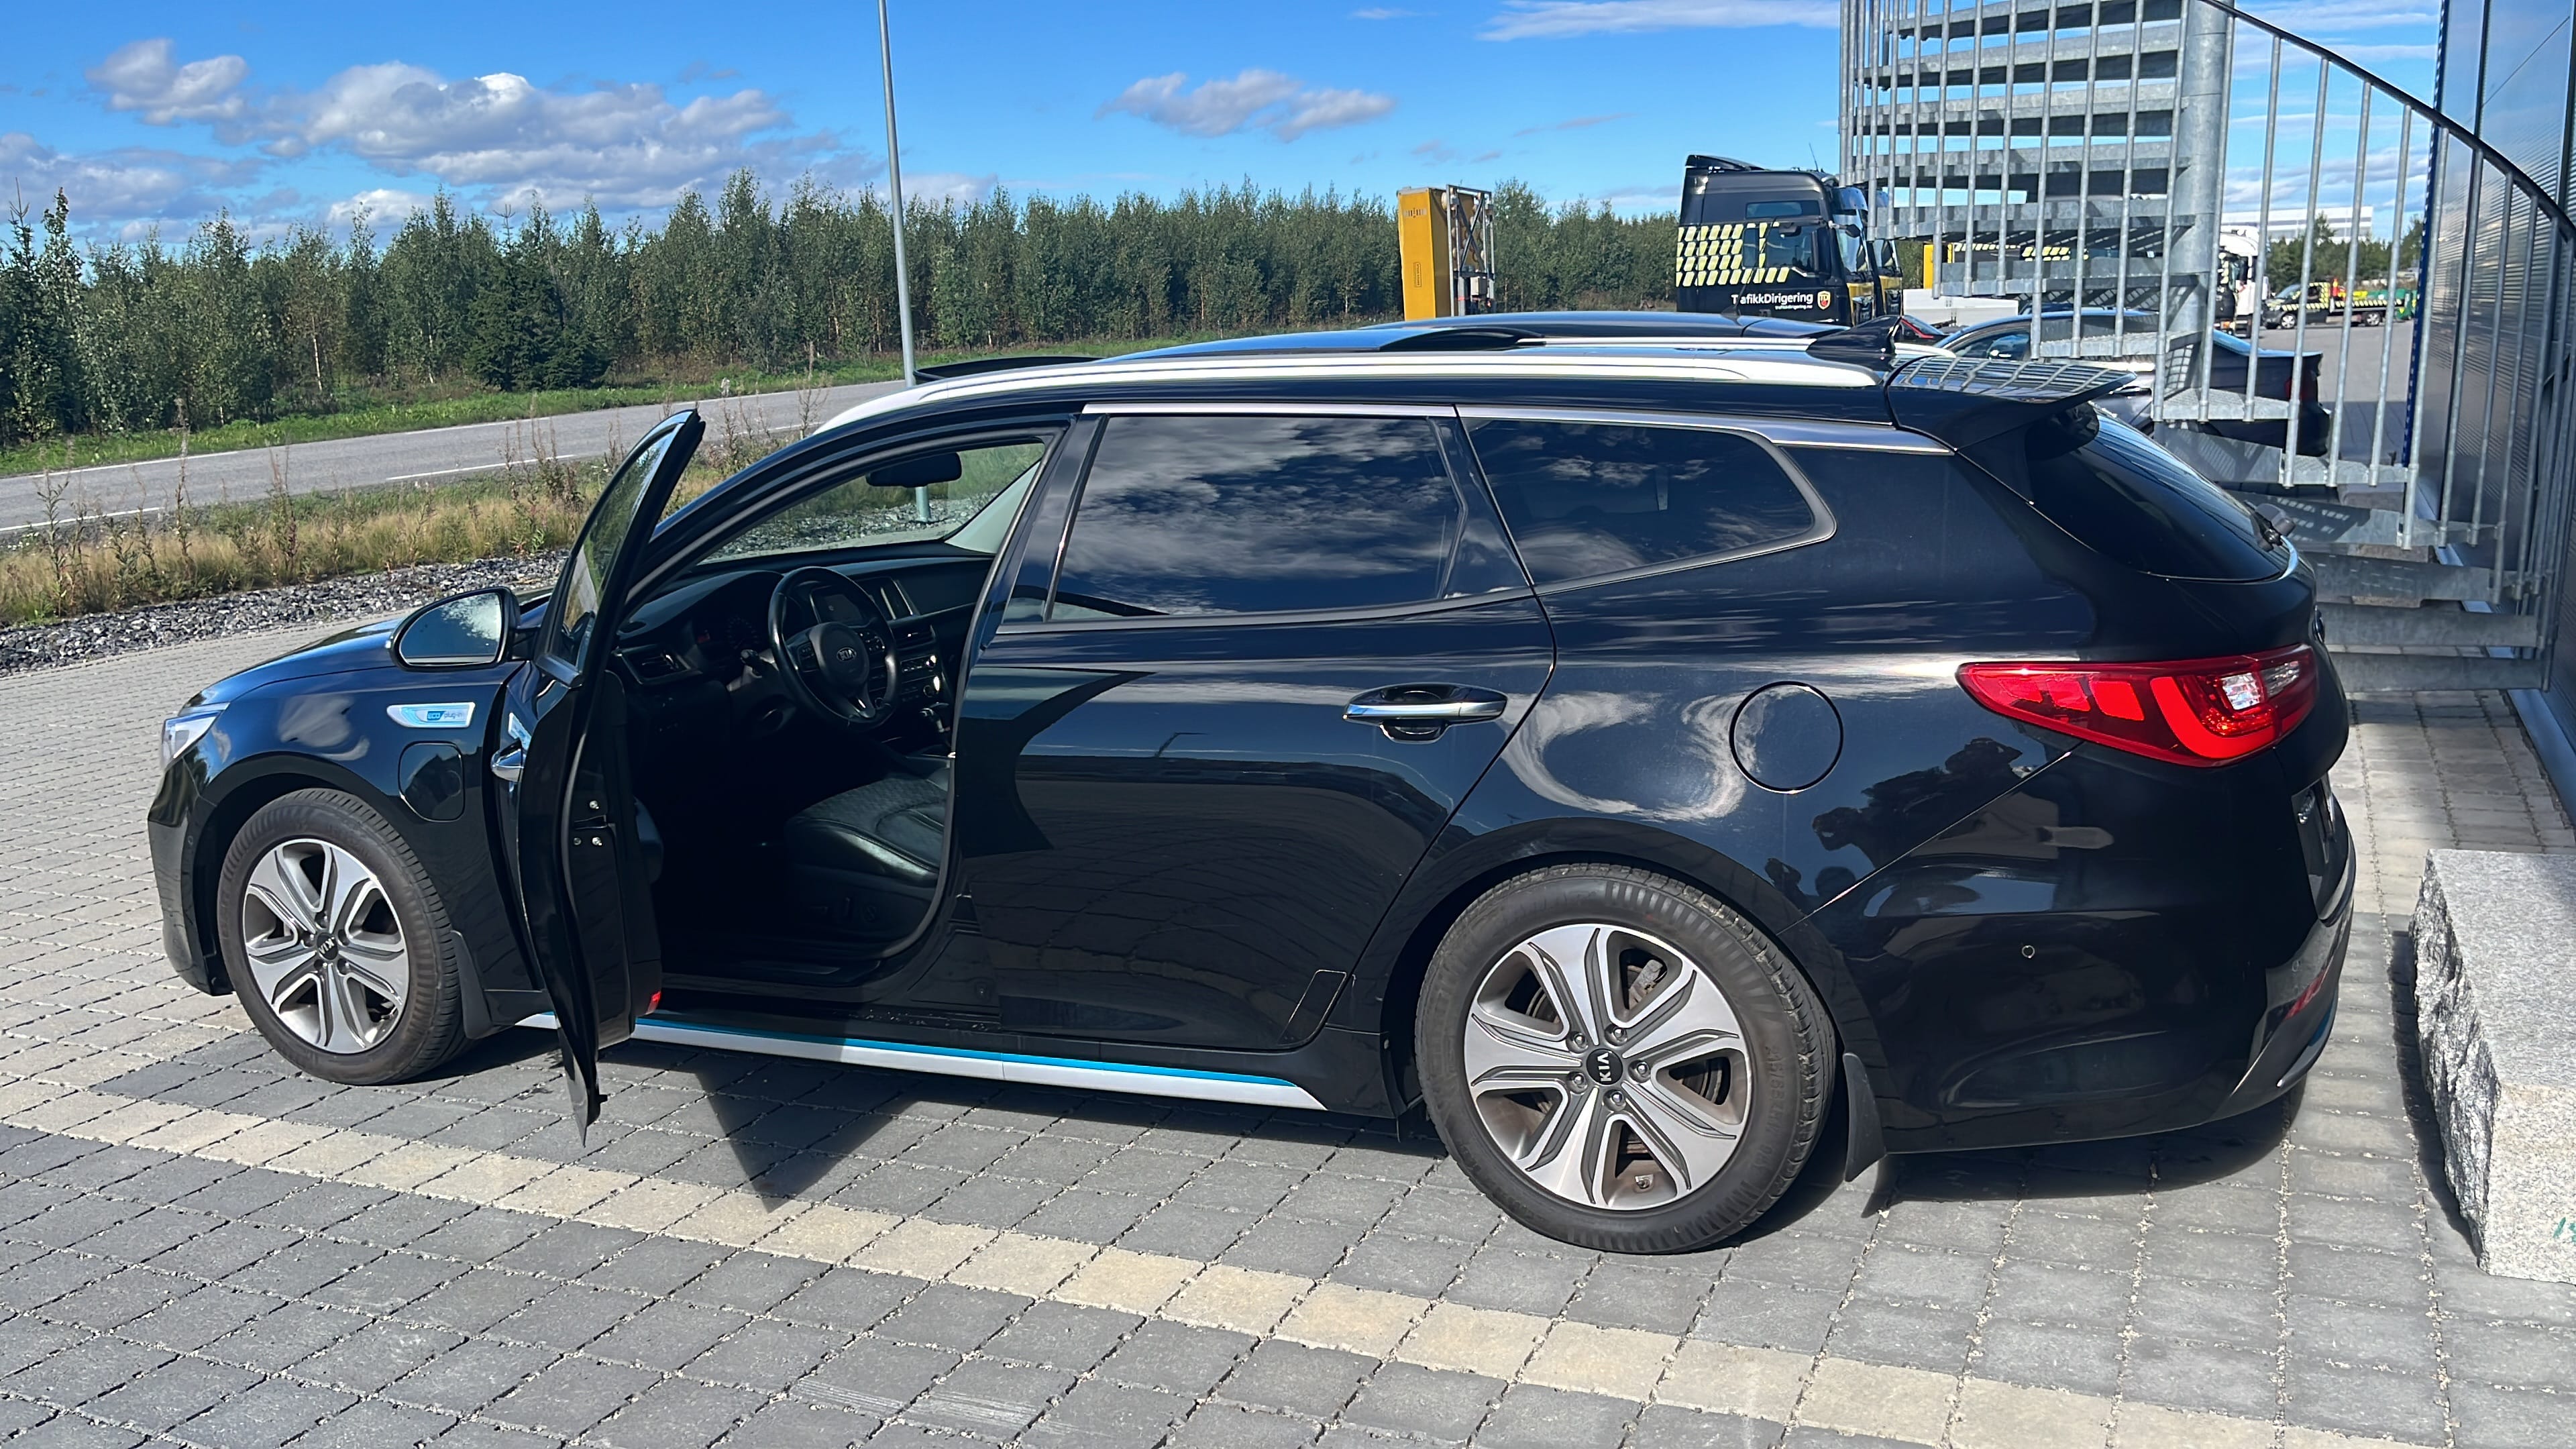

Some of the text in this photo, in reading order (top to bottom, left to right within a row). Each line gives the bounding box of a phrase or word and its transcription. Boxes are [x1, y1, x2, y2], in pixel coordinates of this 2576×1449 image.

[1731, 292, 1813, 305] TafikkDirigering
[319, 938, 335, 954] KIA
[1597, 1052, 1612, 1081] KIA
